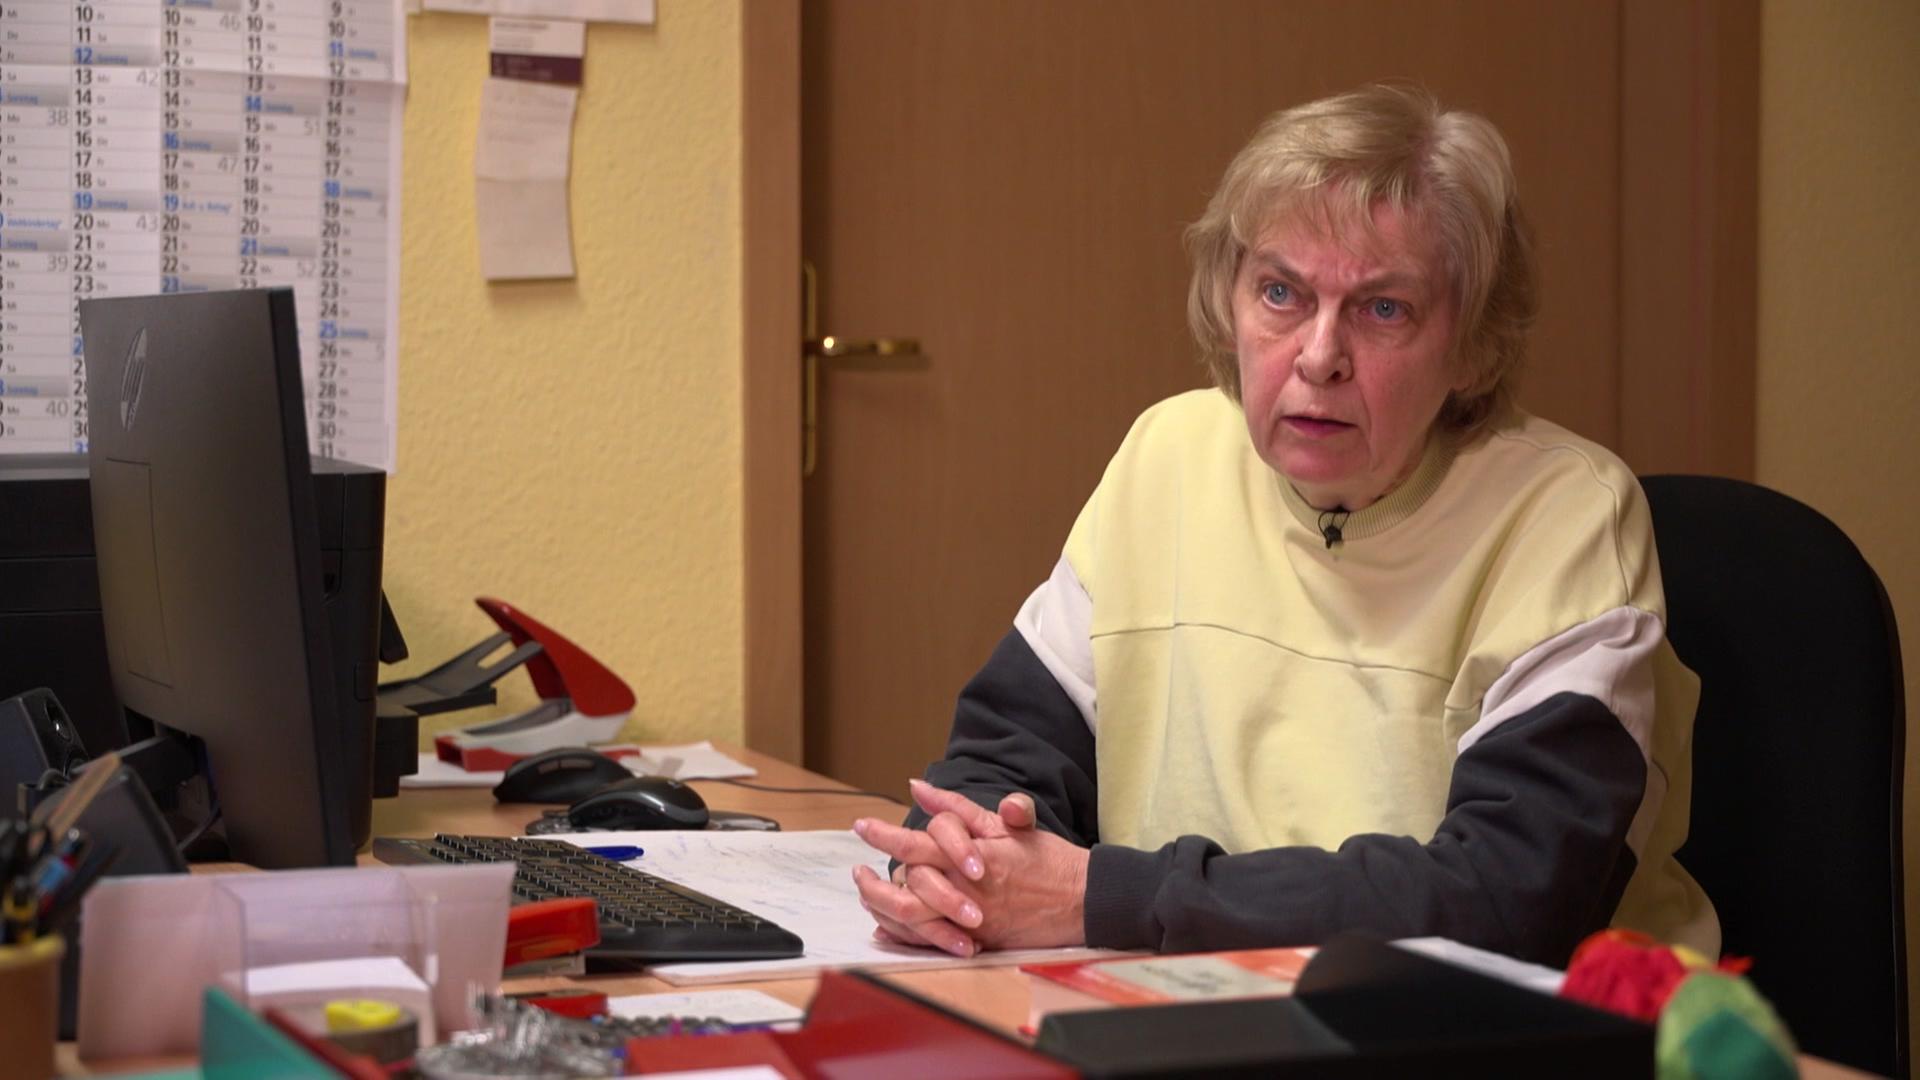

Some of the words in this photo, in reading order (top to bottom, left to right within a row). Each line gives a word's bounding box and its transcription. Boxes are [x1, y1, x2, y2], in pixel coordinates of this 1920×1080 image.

[76, 6, 93, 22] 10
[331, 1, 342, 17] 9
[165, 8, 180, 26] 10
[220, 14, 241, 31] 46
[247, 15, 263, 32] 10
[77, 27, 90, 42] 11
[166, 29, 178, 46] 11
[248, 35, 261, 52] 11
[76, 48, 94, 65] 12
[164, 49, 179, 66] 12
[248, 55, 263, 73] 12
[76, 68, 92, 85] 13
[137, 69, 159, 86] 42
[165, 70, 180, 87] 13
[248, 76, 263, 92] 13
[76, 89, 91, 104] 14
[165, 91, 179, 107] 14
[48, 108, 69, 126] 38
[76, 110, 91, 126] 15
[165, 111, 179, 129] 15
[246, 114, 260, 133] 15
[76, 131, 92, 147] 16
[164, 133, 179, 150] 16
[245, 136, 260, 153] 16
[76, 151, 91, 167] 17
[164, 151, 178, 169] 17
[218, 156, 239, 173] 47
[244, 156, 259, 173] 17
[76, 172, 92, 188] 18
[164, 174, 178, 190] 18
[244, 177, 258, 194] 18
[75, 193, 92, 210] 19
[164, 194, 179, 212] 19
[243, 198, 258, 214] 19
[74, 213, 93, 230] 20
[136, 214, 158, 232] 43
[163, 214, 179, 232] 20
[241, 217, 259, 235] 20
[75, 234, 91, 250] 21
[163, 234, 177, 252] 21
[240, 238, 257, 255] 21
[48, 255, 69, 272] 39
[74, 255, 92, 271] 22
[163, 255, 178, 273] 22
[240, 256, 257, 275] 22
[74, 275, 93, 292] 23
[46, 400, 69, 417] 40
